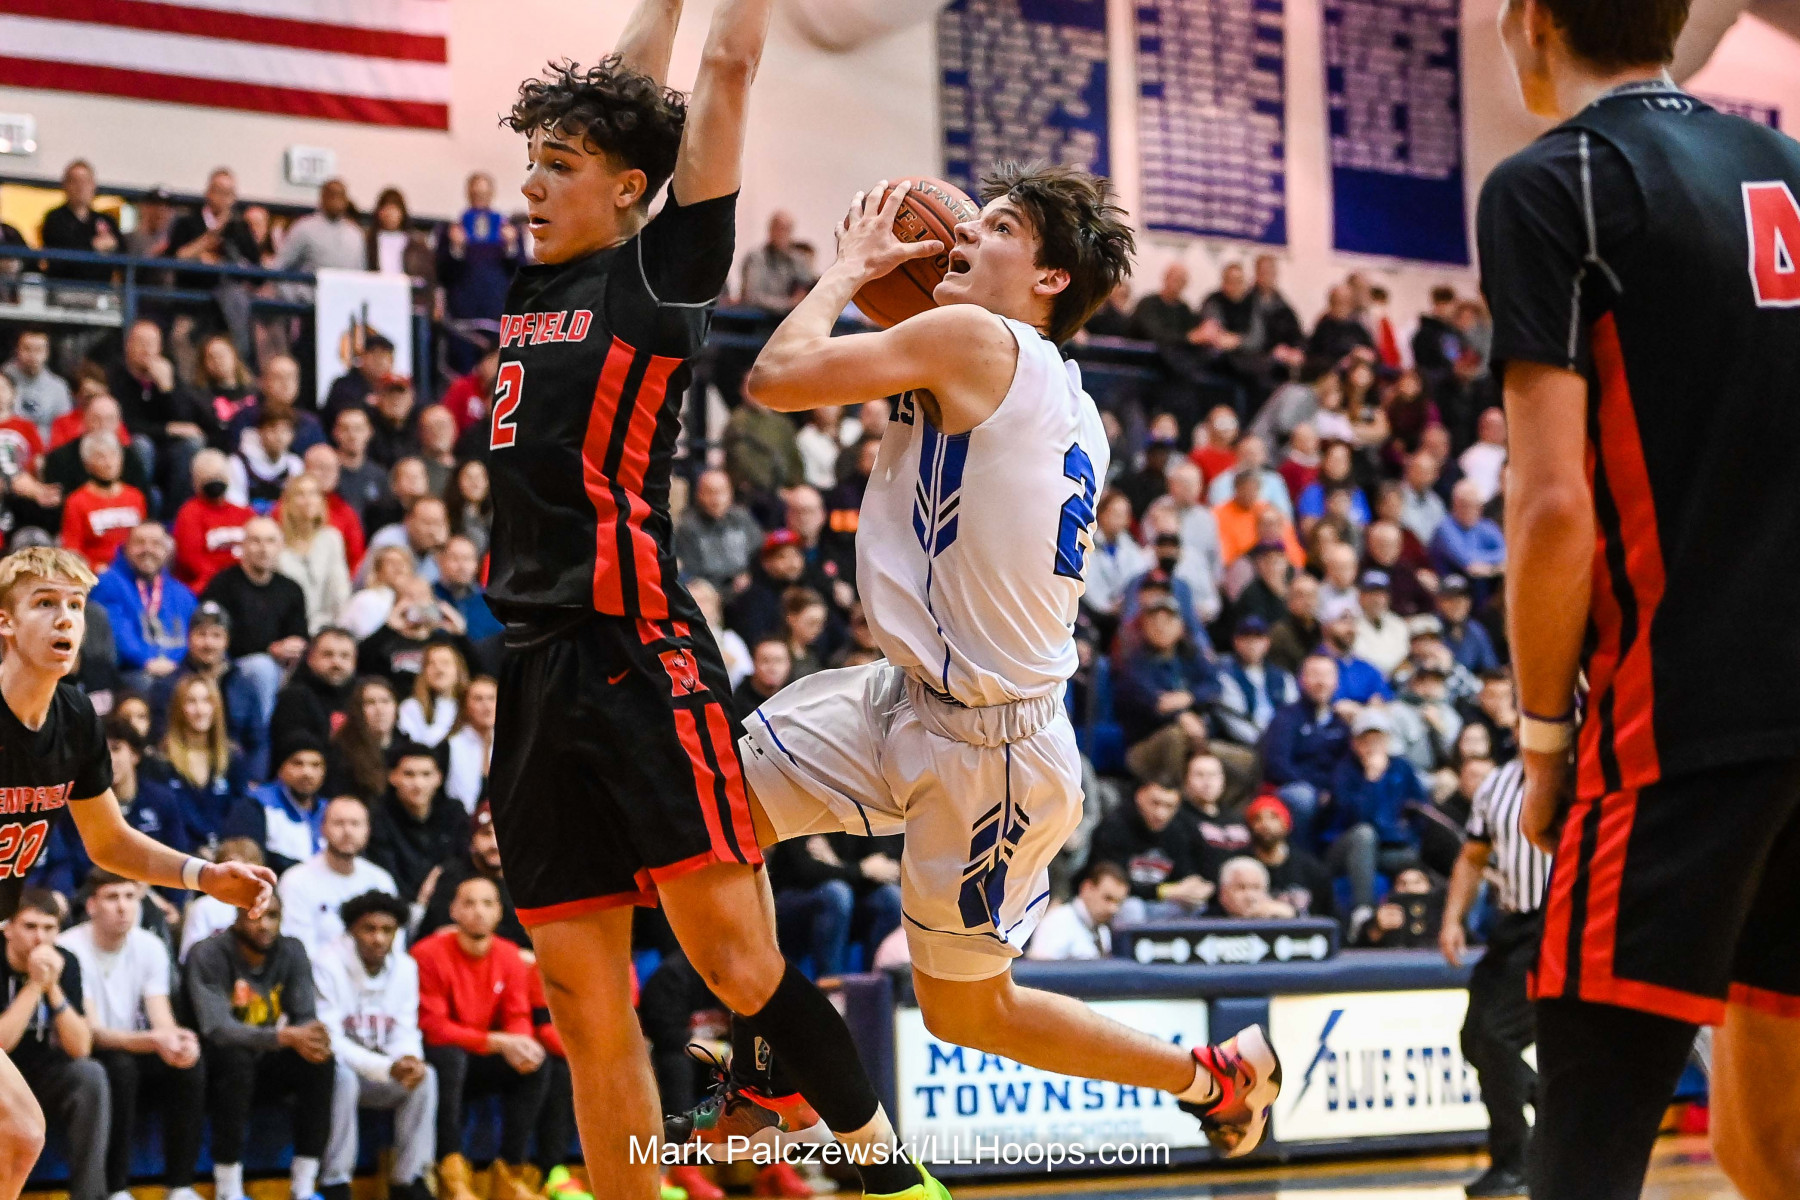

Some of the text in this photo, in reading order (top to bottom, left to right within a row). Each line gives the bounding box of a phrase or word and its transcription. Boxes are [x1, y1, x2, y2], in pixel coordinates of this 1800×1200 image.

[500, 309, 594, 348] PFIELD
[490, 360, 525, 451] 2
[1053, 441, 1097, 582] 2
[915, 1080, 1163, 1118] TOWNSHI
